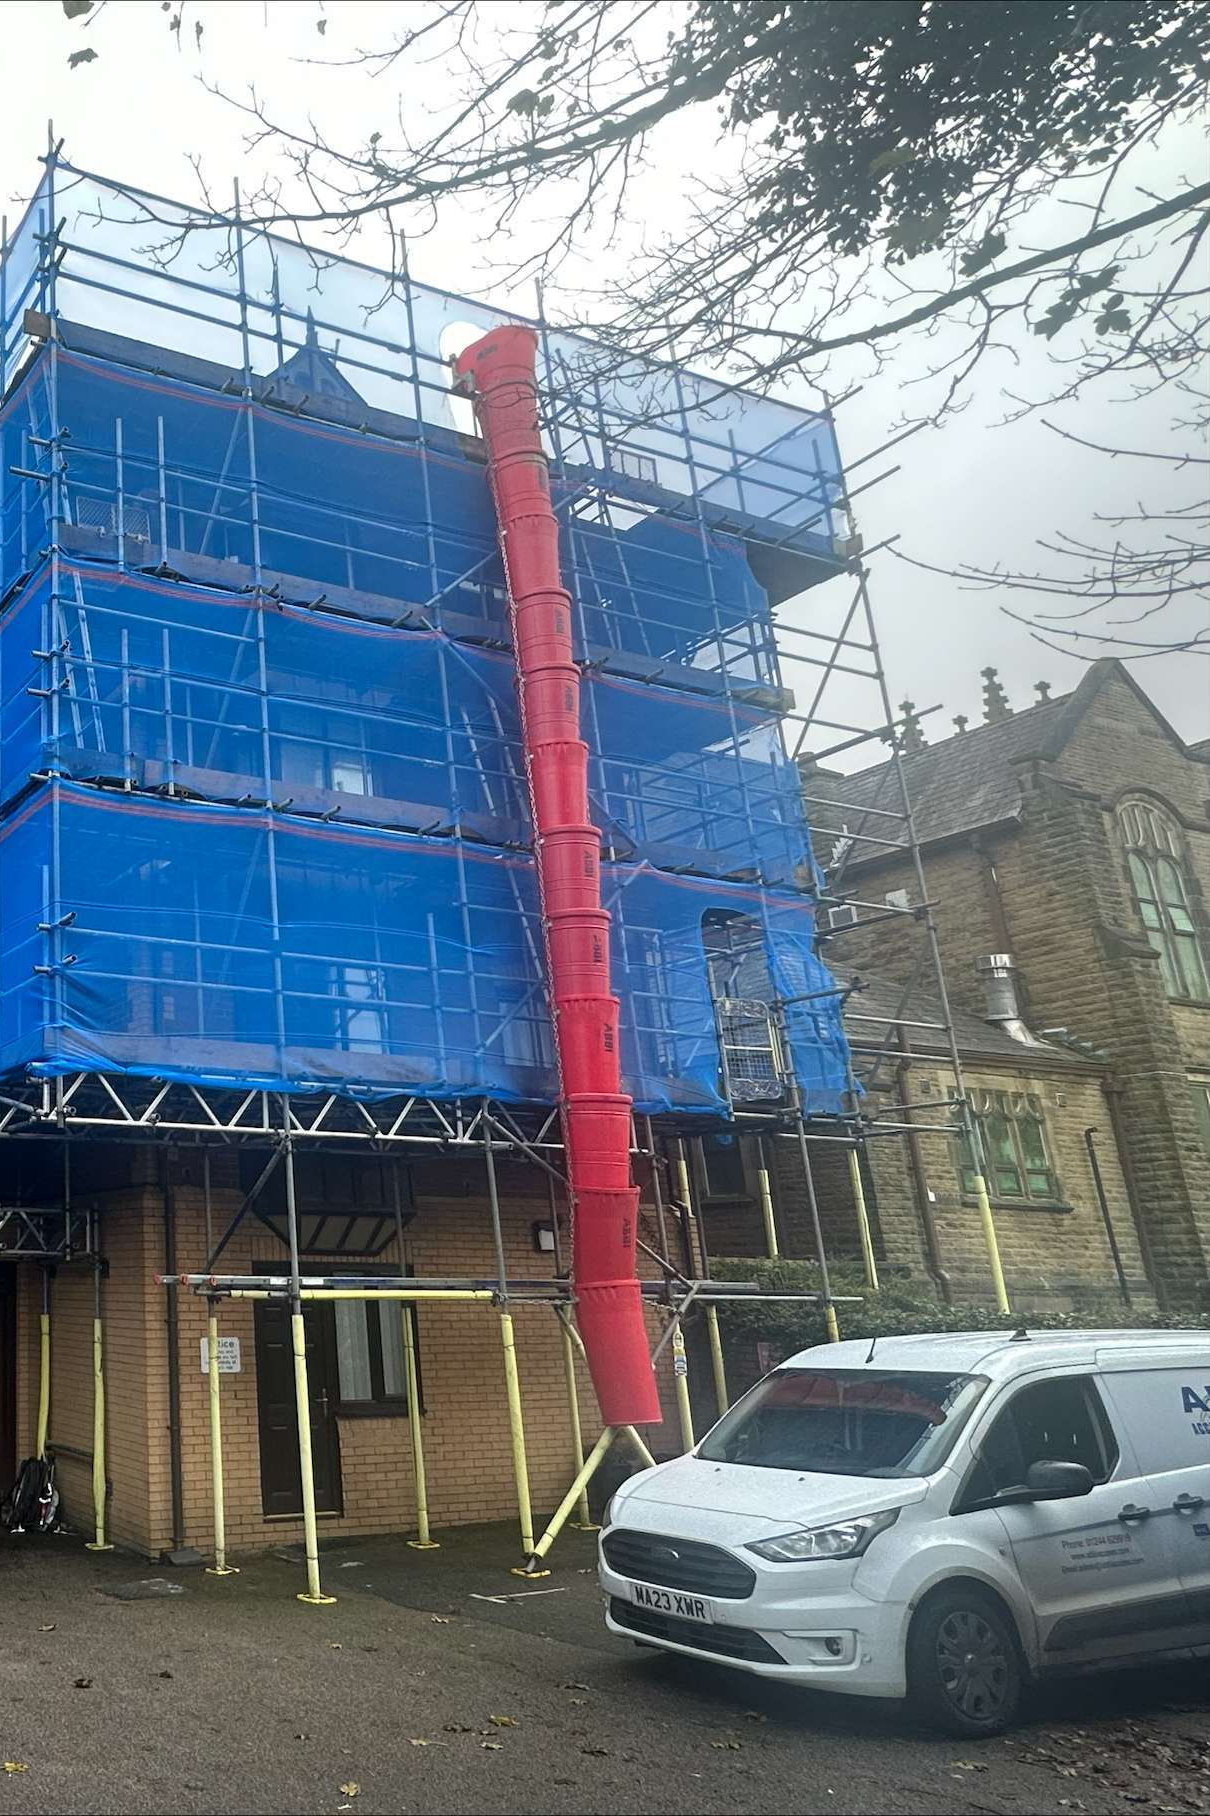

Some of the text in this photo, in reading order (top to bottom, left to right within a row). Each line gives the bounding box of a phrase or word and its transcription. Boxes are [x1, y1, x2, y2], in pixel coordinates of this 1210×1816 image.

[604, 1023, 614, 1053] ABBI
[635, 1585, 706, 1619] MA23 XWR
